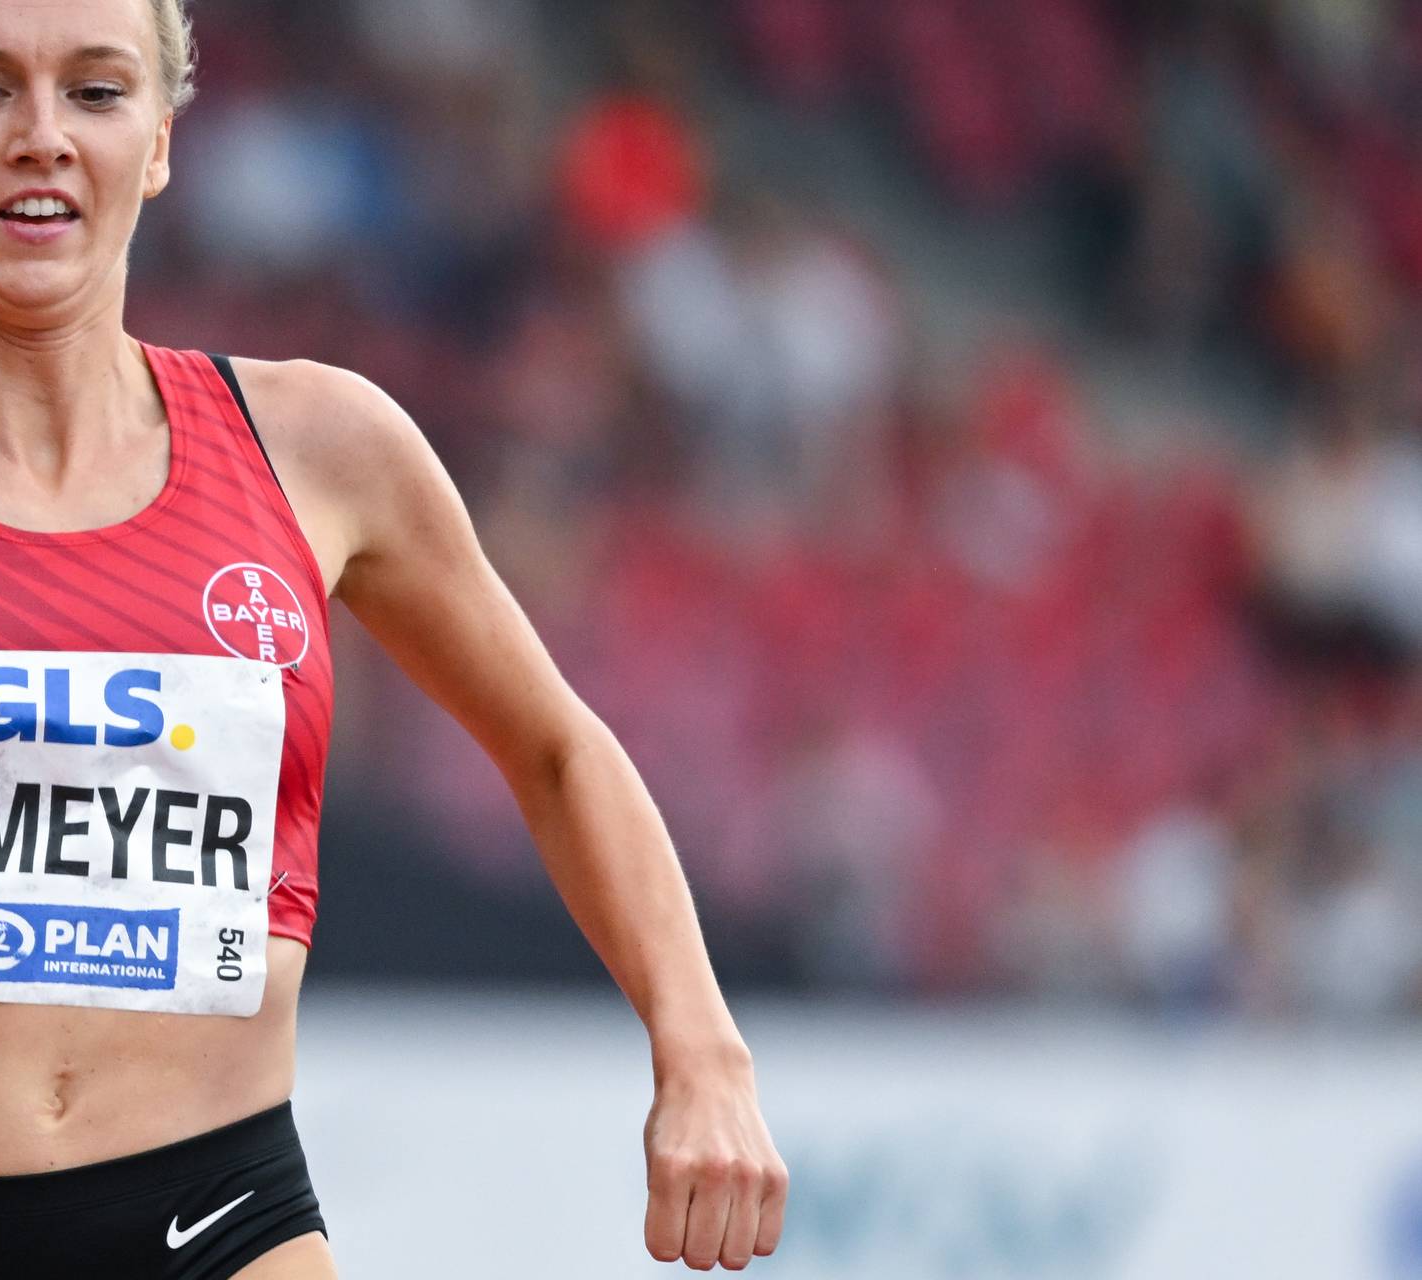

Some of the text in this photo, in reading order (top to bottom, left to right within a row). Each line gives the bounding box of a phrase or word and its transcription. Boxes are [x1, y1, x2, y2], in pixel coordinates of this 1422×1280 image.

[212, 603, 304, 632] BAYER
[242, 570, 277, 662] BAYER
[45, 919, 169, 961] PLAN
[216, 927, 245, 983] 540
[44, 960, 166, 980] INTERNATIONAL
